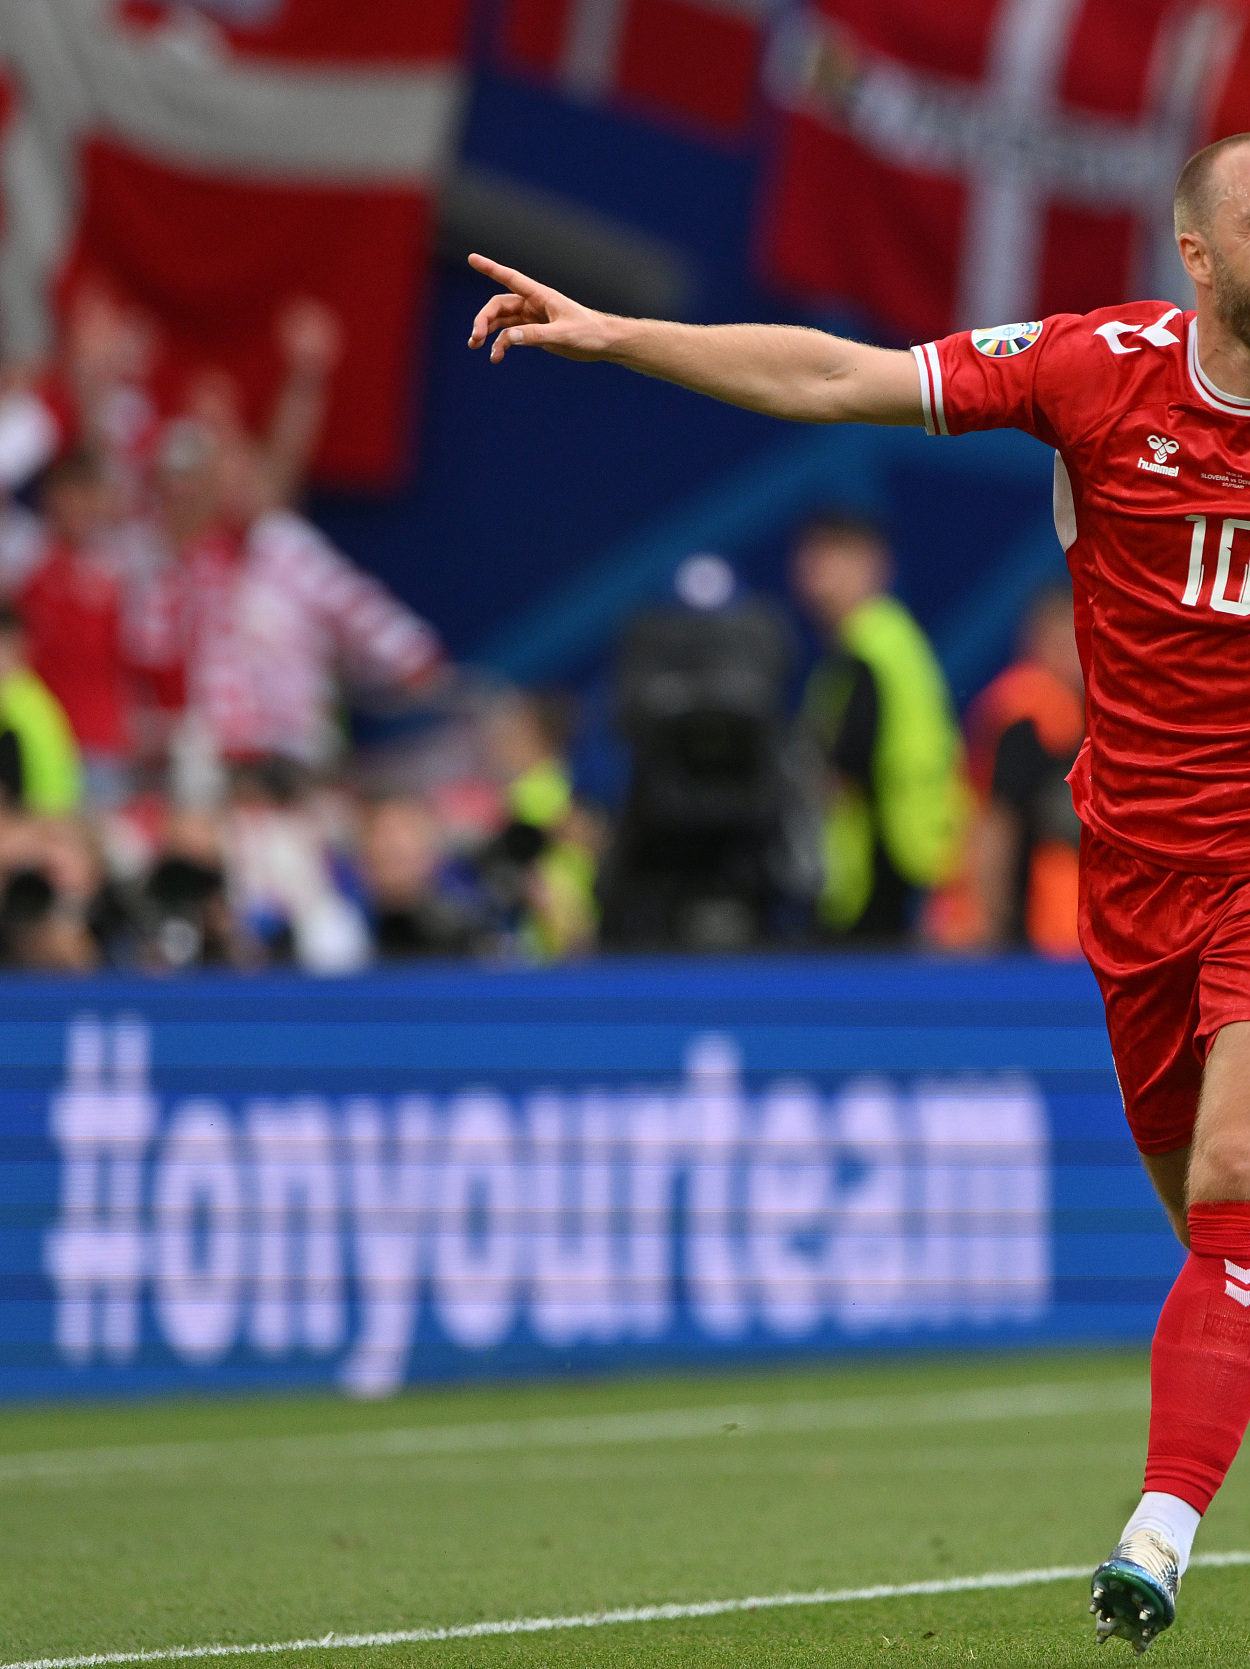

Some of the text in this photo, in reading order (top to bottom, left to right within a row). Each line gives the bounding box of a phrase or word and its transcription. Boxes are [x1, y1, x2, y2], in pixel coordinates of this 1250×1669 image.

[1137, 457, 1179, 477] hummel
[1201, 473, 1229, 481] SLOVENIA
[45, 1016, 1052, 1396] #onyourteam
